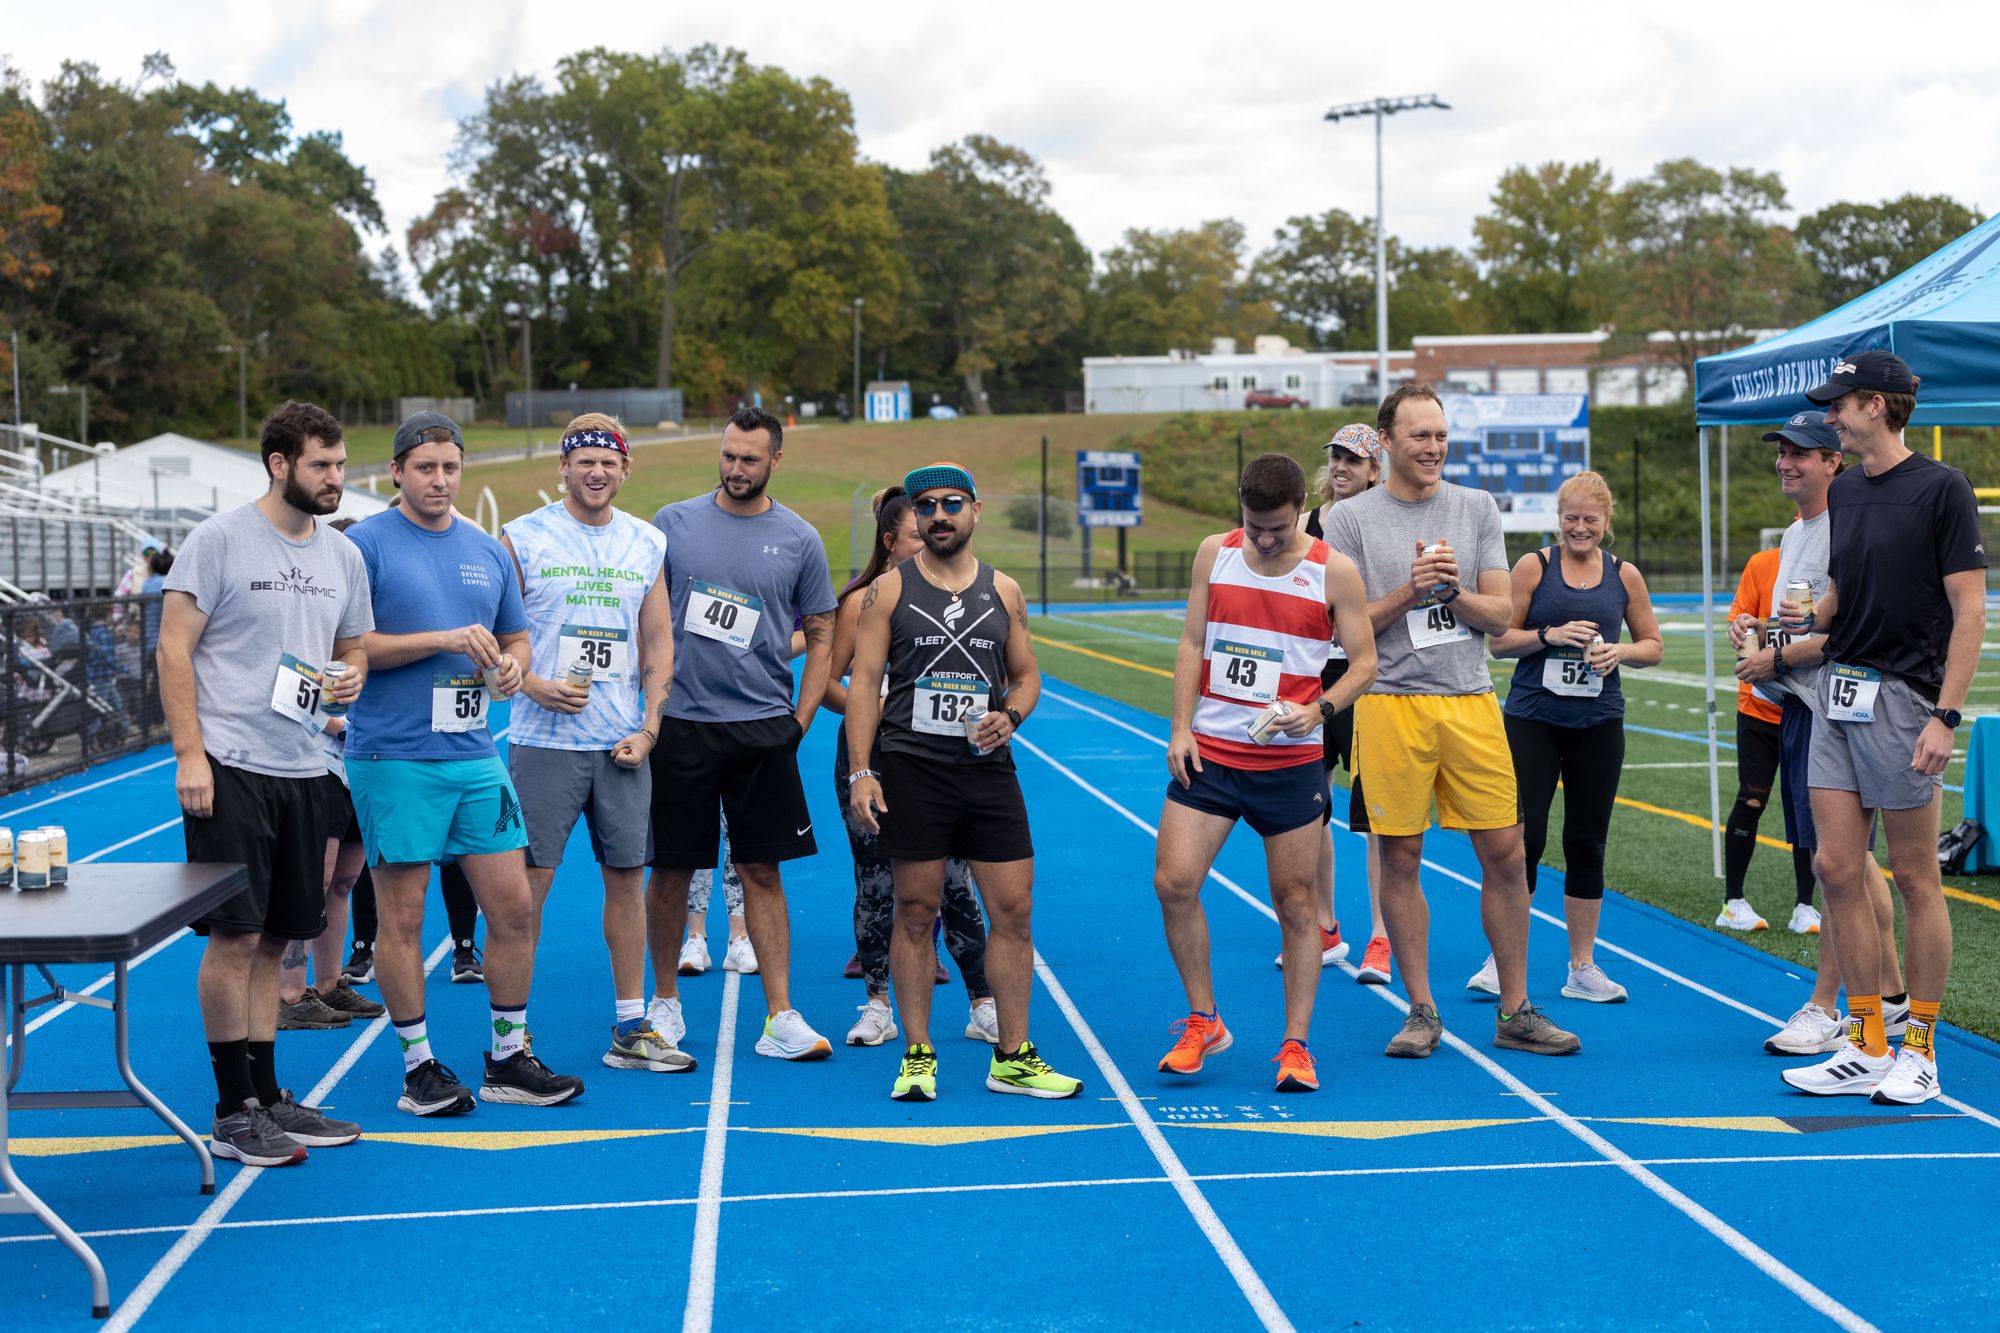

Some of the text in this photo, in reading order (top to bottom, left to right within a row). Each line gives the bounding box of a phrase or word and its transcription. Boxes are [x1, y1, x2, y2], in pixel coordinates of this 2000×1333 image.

[1731, 366, 1775, 402] ATHLETIC
[1776, 358, 1827, 397] BREWING
[541, 566, 644, 585] MENTAL HEALTH
[576, 581, 613, 593] LIVES
[566, 594, 620, 608] MATTER
[706, 587, 748, 605] NA BEER MILE
[704, 600, 738, 630] 40
[1428, 605, 1457, 632] 49
[580, 640, 612, 669] 35
[914, 635, 995, 650] FLEET FEET
[1234, 646, 1249, 655] BEER
[1250, 649, 1267, 657] MILE
[295, 663, 304, 673] NA
[931, 671, 977, 680] WESTPORT
[1226, 657, 1257, 687] 43
[1562, 661, 1588, 685] 52
[1852, 670, 1867, 678] MILE
[297, 677, 320, 716] 51
[455, 689, 482, 719] 53
[1832, 678, 1859, 707] 45
[929, 693, 975, 722] 132
